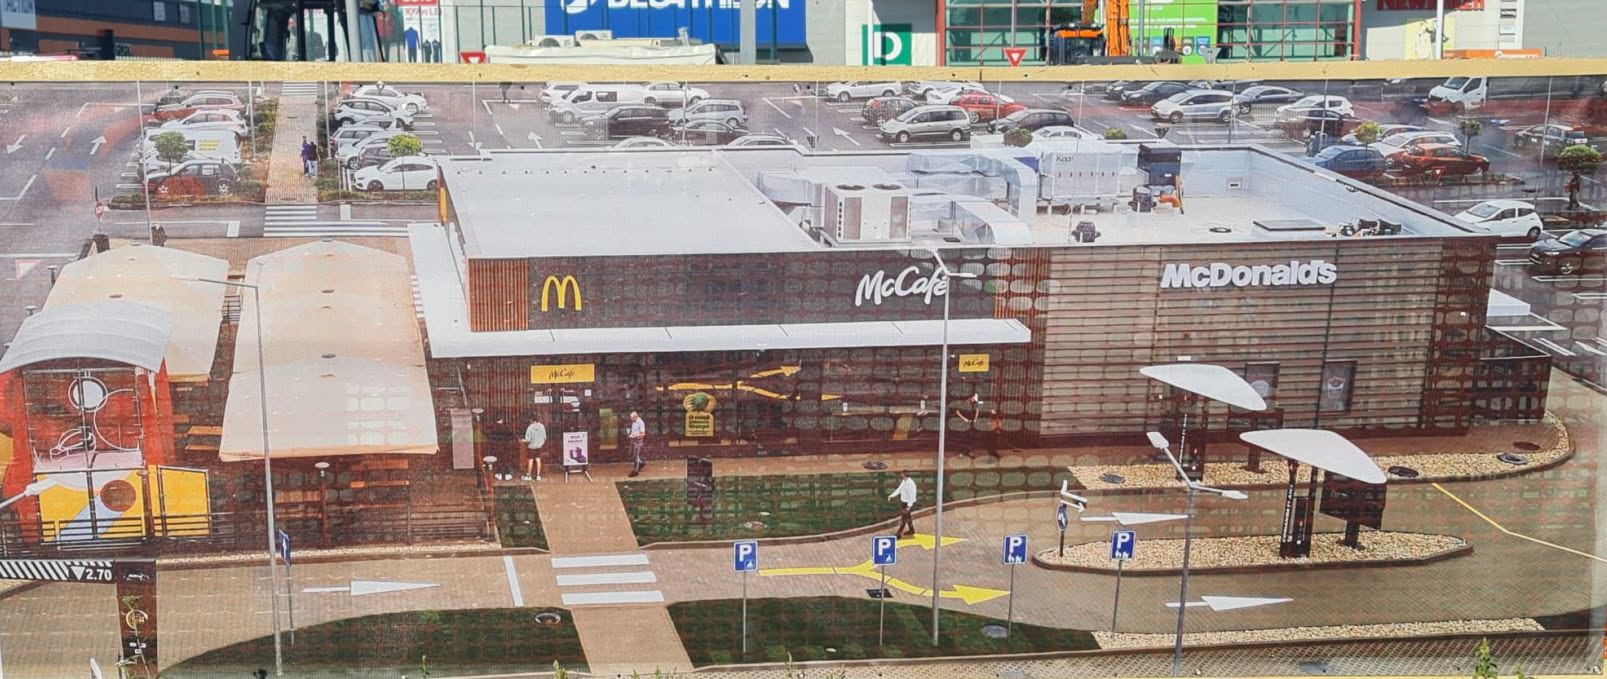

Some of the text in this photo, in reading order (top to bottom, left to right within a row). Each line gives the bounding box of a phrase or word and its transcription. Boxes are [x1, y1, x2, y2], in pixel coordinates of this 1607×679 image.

[1161, 259, 1337, 288] McDonald's
[877, 538, 892, 554] P
[1009, 537, 1023, 553] P
[1117, 533, 1130, 549] P
[738, 543, 752, 561] P
[86, 568, 112, 580] 2.70
